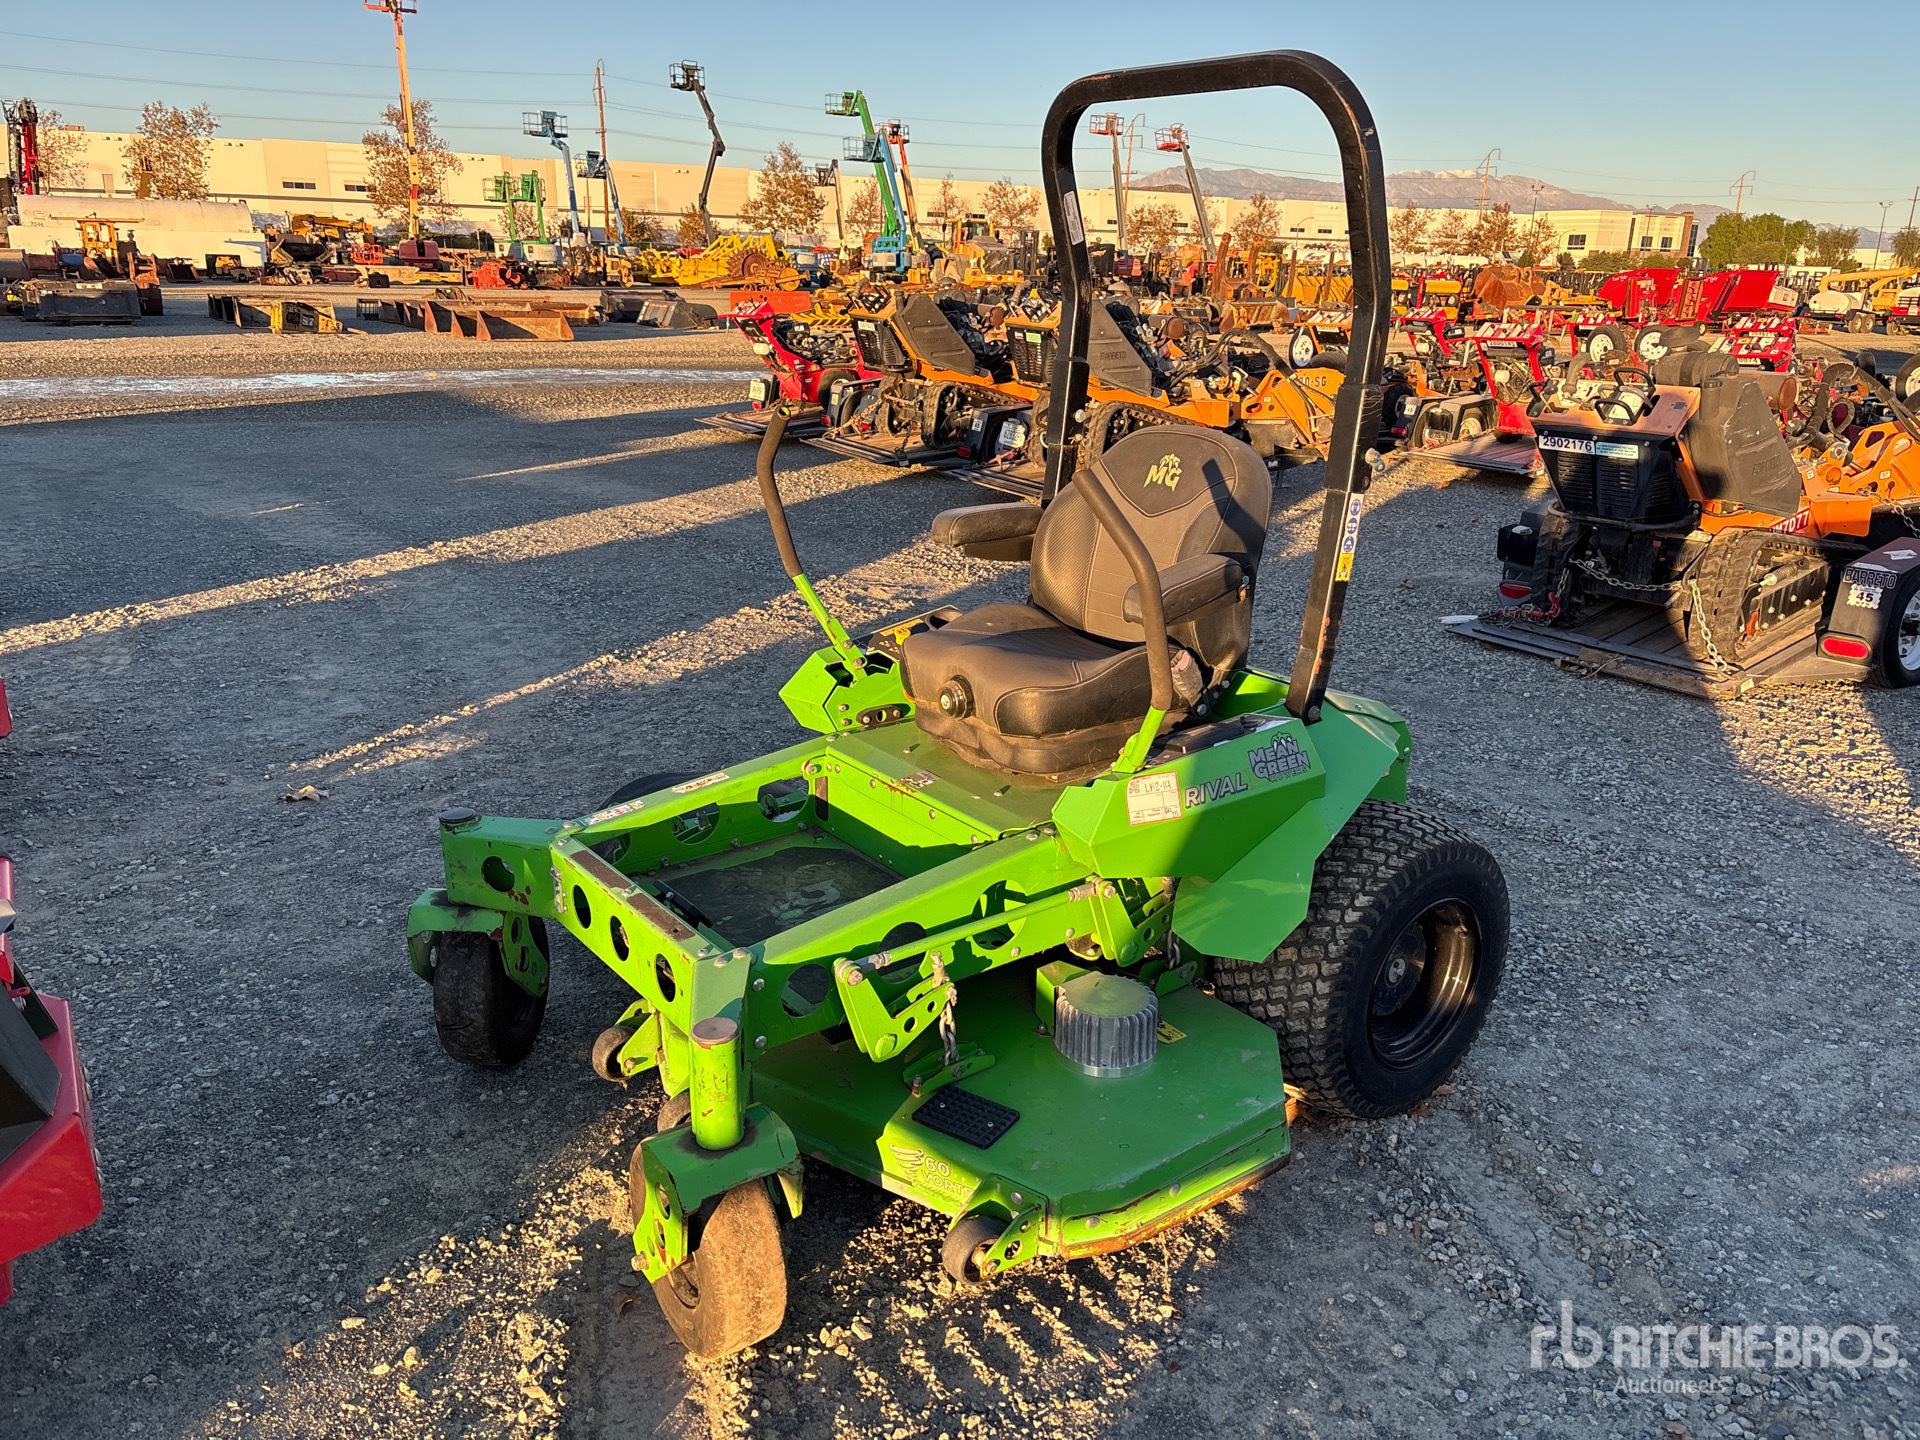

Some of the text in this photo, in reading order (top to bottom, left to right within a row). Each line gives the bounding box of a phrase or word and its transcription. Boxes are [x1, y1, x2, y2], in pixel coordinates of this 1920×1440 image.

[1543, 436, 1592, 452] 2902176
[1143, 464, 1182, 492] MG
[1844, 567, 1898, 590] BARRETO
[1856, 591, 1875, 604] 45
[1248, 740, 1300, 766] MEAN
[1253, 750, 1311, 780] GREEN
[1269, 766, 1308, 782] MOWERS
[1184, 772, 1249, 809] RIVAL
[924, 1156, 951, 1177] 60
[921, 1170, 976, 1196] VORTE
